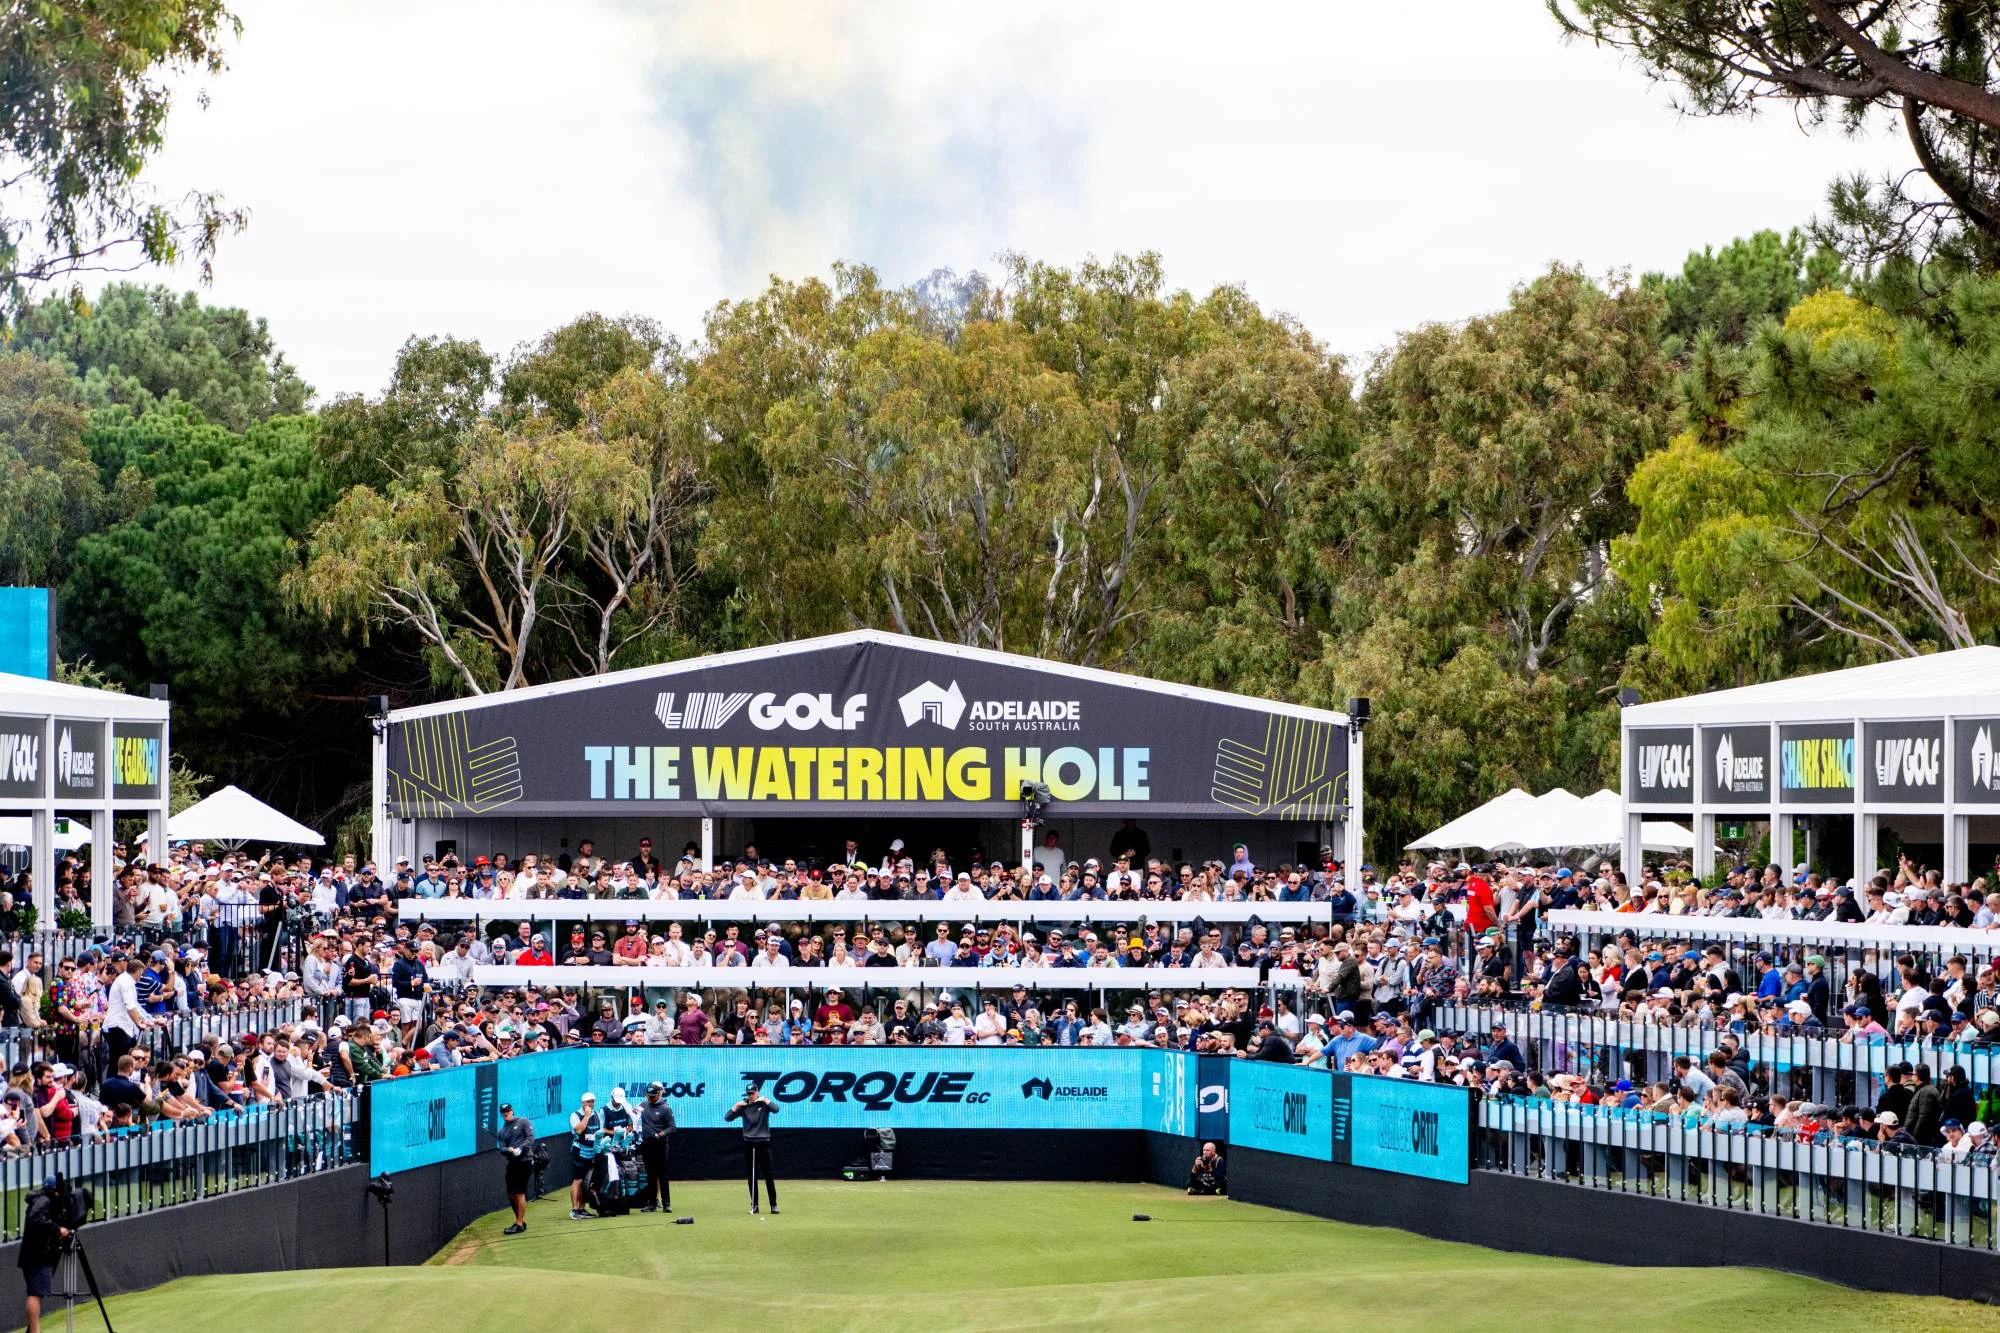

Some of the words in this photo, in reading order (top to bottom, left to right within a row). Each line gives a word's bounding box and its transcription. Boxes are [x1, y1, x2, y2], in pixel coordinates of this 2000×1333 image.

[969, 701, 1081, 720] ADELAIDE
[969, 721, 1010, 731] SOUTH
[1014, 721, 1081, 731] AUSTRALIA
[72, 752, 94, 774] ADELAIDE
[125, 736, 159, 785] GARDEN
[584, 746, 680, 799] THE
[692, 746, 991, 801] WATERING
[1004, 746, 1150, 801] HOLE
[1734, 757, 1764, 779] ADELAIDE
[1782, 739, 1820, 789] SHARK
[740, 1071, 975, 1111] TORQUE
[965, 1092, 992, 1104] GC
[1055, 1087, 1108, 1096] ADELAIDE
[1283, 1091, 1307, 1136] ORTIZ
[1412, 1109, 1439, 1156] ORTIZ
